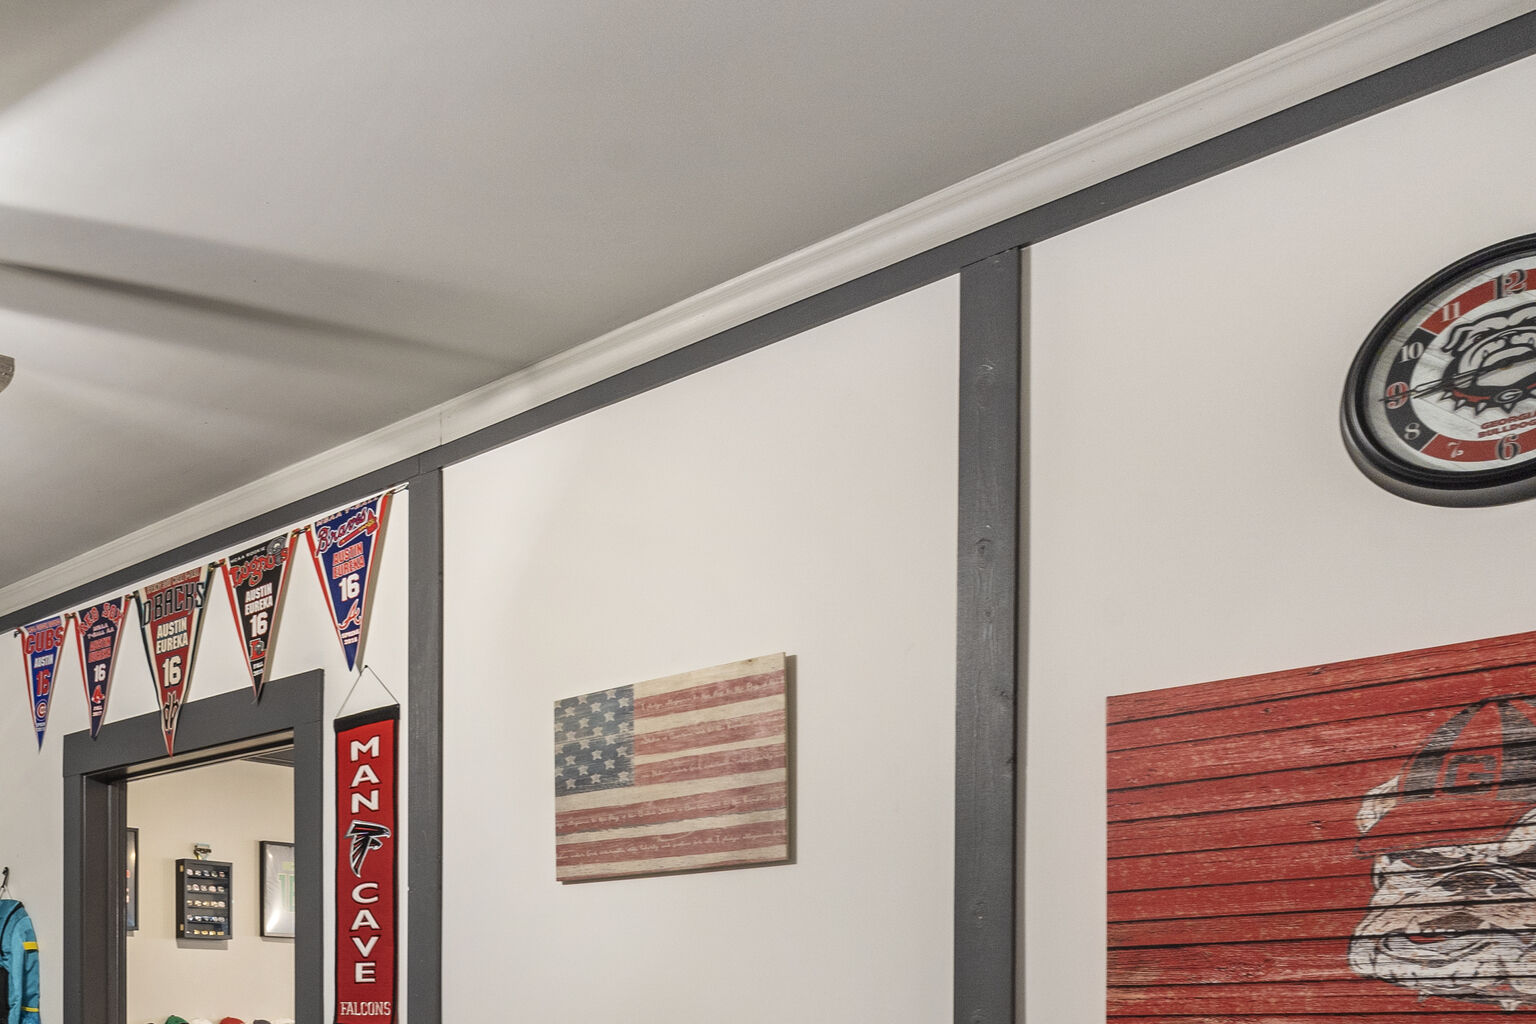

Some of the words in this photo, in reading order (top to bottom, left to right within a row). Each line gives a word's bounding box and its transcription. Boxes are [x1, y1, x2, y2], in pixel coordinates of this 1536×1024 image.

[1493, 269, 1527, 300] 12
[1440, 302, 1462, 322] 11
[1400, 342, 1424, 363] 10
[1386, 381, 1410, 410] 9
[1405, 423, 1421, 441] 8
[1447, 441, 1464, 458] 7
[1496, 433, 1521, 460] 6
[332, 541, 363, 566] AUSTIN
[332, 555, 365, 580] EUREKA
[245, 582, 273, 603] AUSTIN
[338, 573, 360, 602] 16
[244, 595, 273, 616] EUREKA
[157, 617, 187, 640] AUSTIN
[249, 611, 269, 638] 16
[24, 626, 64, 654] CUBS
[156, 632, 189, 655] EUREKA
[36, 671, 51, 696] 16
[93, 664, 106, 682] 16
[162, 655, 182, 688] 16
[349, 736, 381, 814] MAN
[350, 882, 381, 984] CAVE
[340, 1001, 391, 1017] FALCONS
